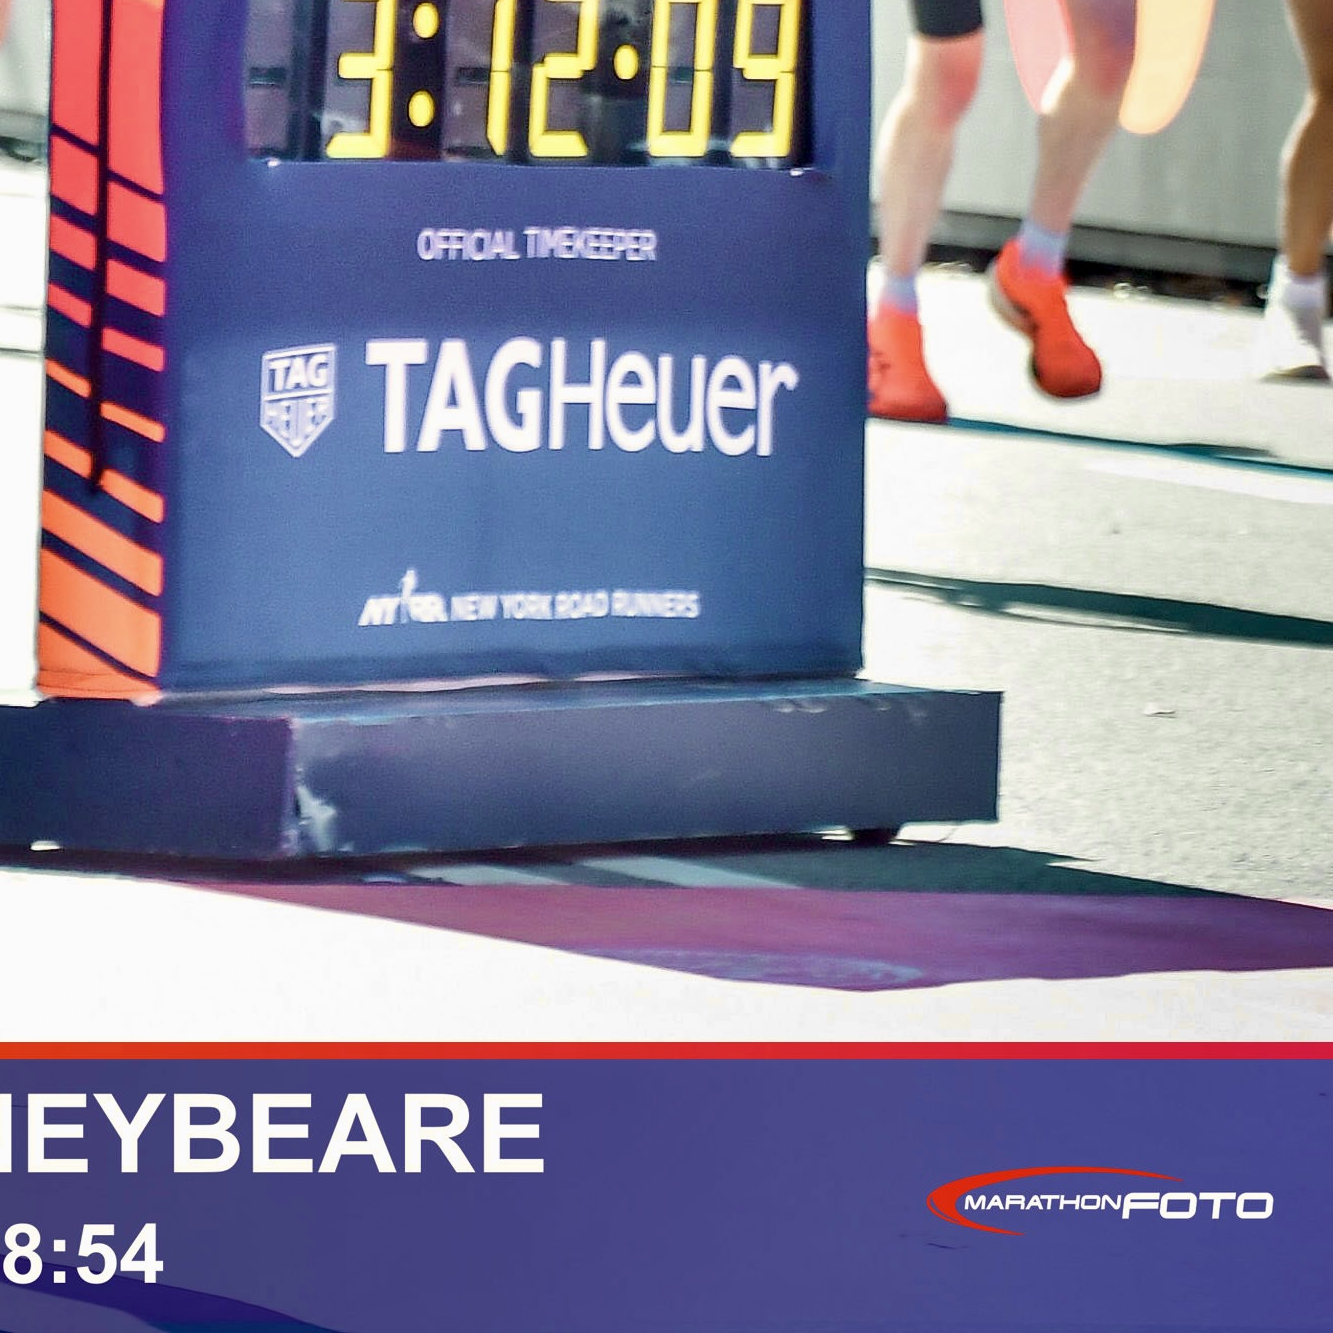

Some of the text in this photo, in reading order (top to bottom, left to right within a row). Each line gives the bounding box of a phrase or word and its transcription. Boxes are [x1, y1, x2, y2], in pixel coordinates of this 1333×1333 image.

[417, 226, 657, 261] OFFICIAL TIMEKEEPER
[269, 354, 328, 391] TAG
[451, 594, 499, 621] NEW
[499, 593, 554, 620] YORK
[554, 591, 610, 619] ROAD
[611, 590, 700, 618] RUNNERS
